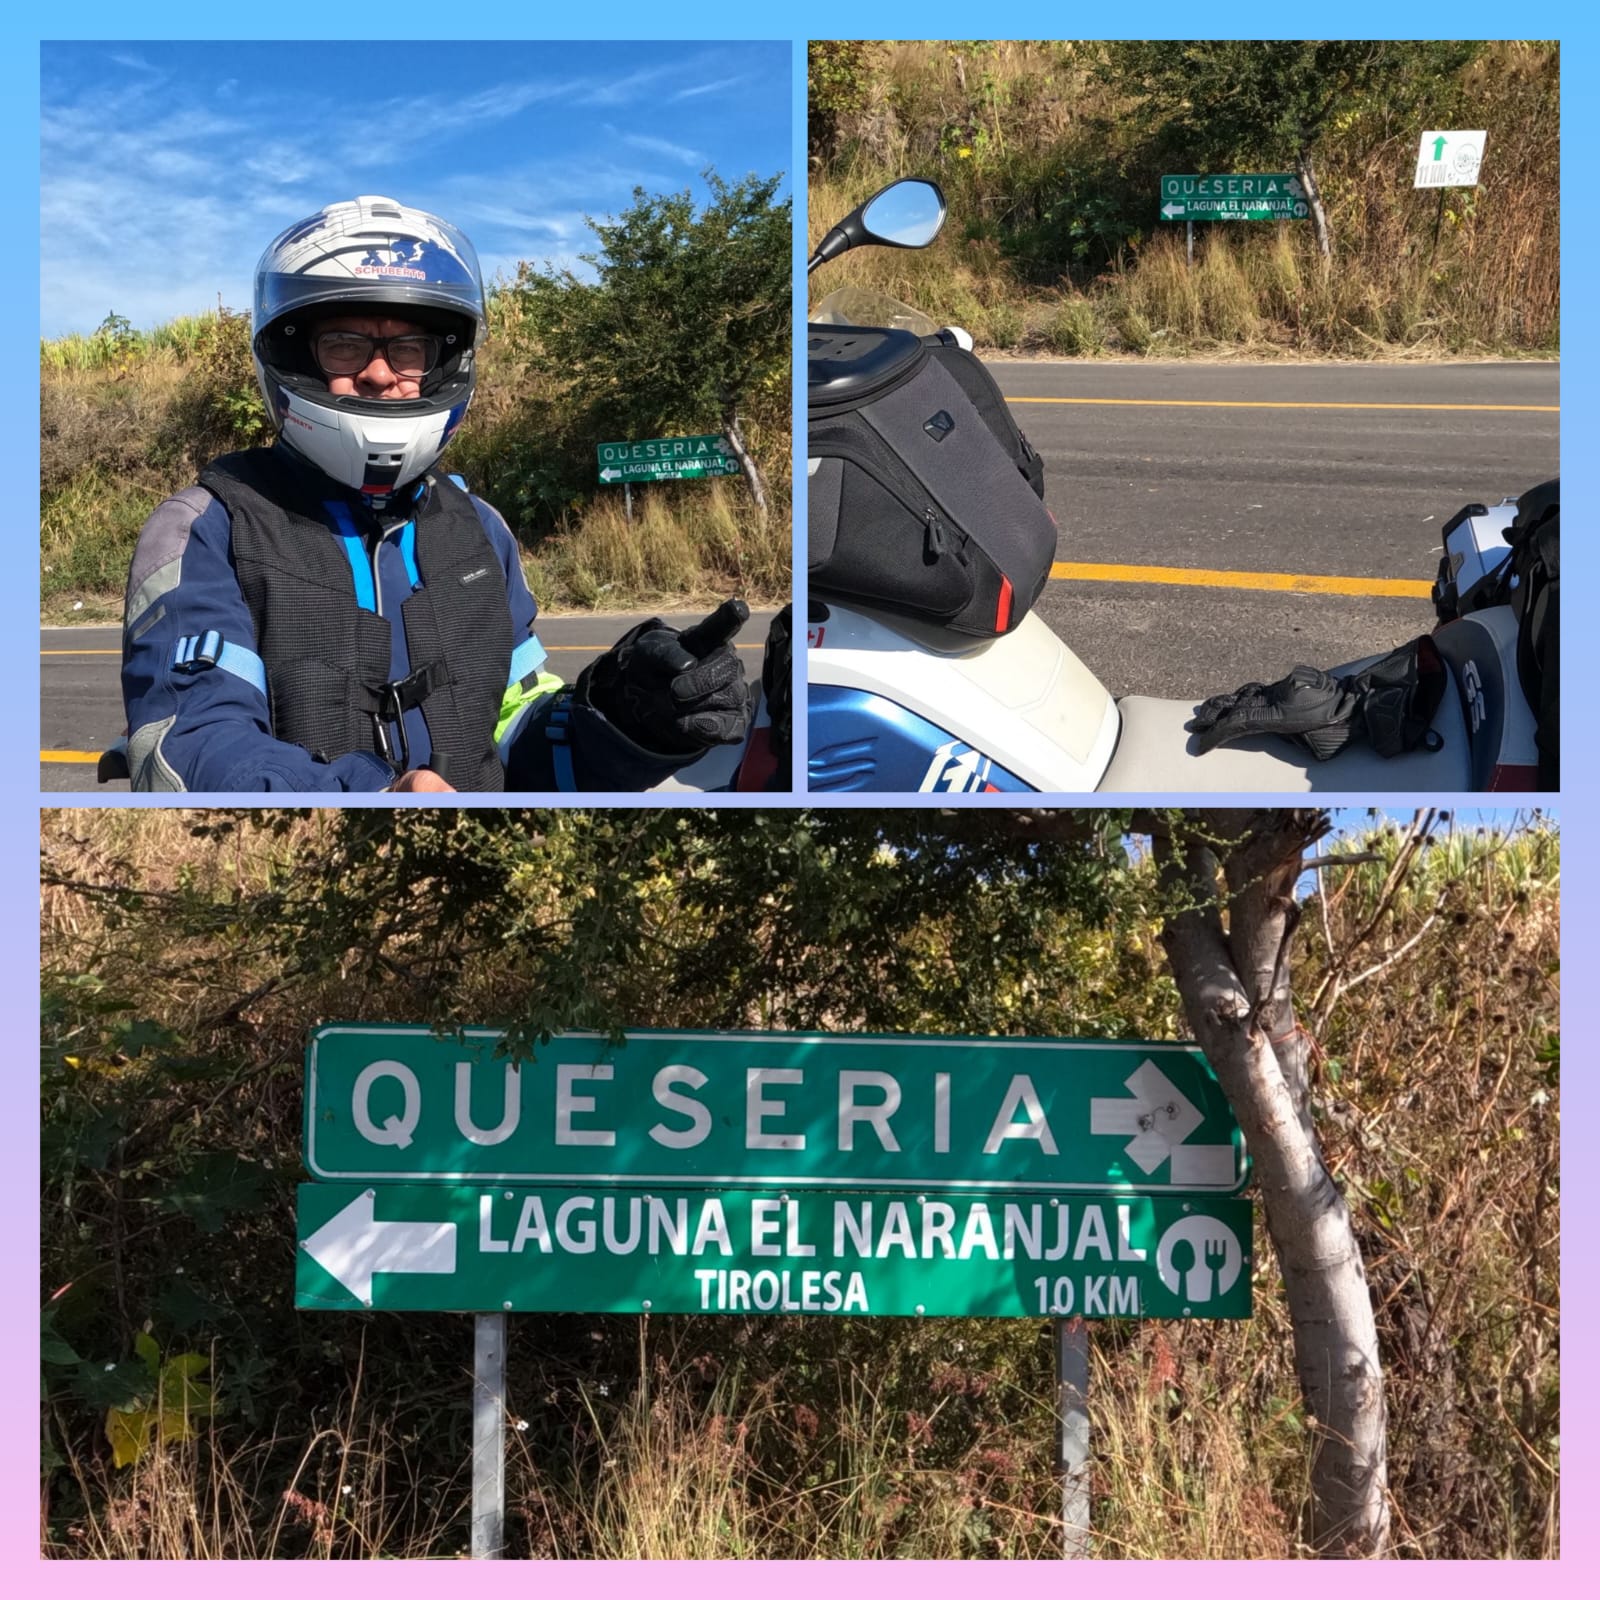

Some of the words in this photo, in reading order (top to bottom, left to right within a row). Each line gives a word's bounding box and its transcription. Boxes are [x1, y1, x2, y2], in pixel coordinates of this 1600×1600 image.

[1167, 179, 1279, 195] QUESERIA
[1187, 200, 1227, 211] LAGUNA
[1228, 200, 1240, 211] EL
[1241, 199, 1293, 211] NARANJAL
[354, 266, 426, 280] SCHUBERTH
[603, 440, 709, 461] QUESERIA
[623, 462, 662, 474] LAGUNA
[662, 461, 674, 472] EL
[674, 456, 726, 470] NARANJAL
[352, 1060, 1060, 1155] QUESERIA
[479, 1195, 733, 1256] LAGUNA
[751, 1199, 816, 1257] EL
[833, 1201, 1147, 1261] NARANJAL
[694, 1269, 869, 1313] TIROLESA
[1034, 1275, 1075, 1315] 10
[1084, 1275, 1139, 1316] KM
